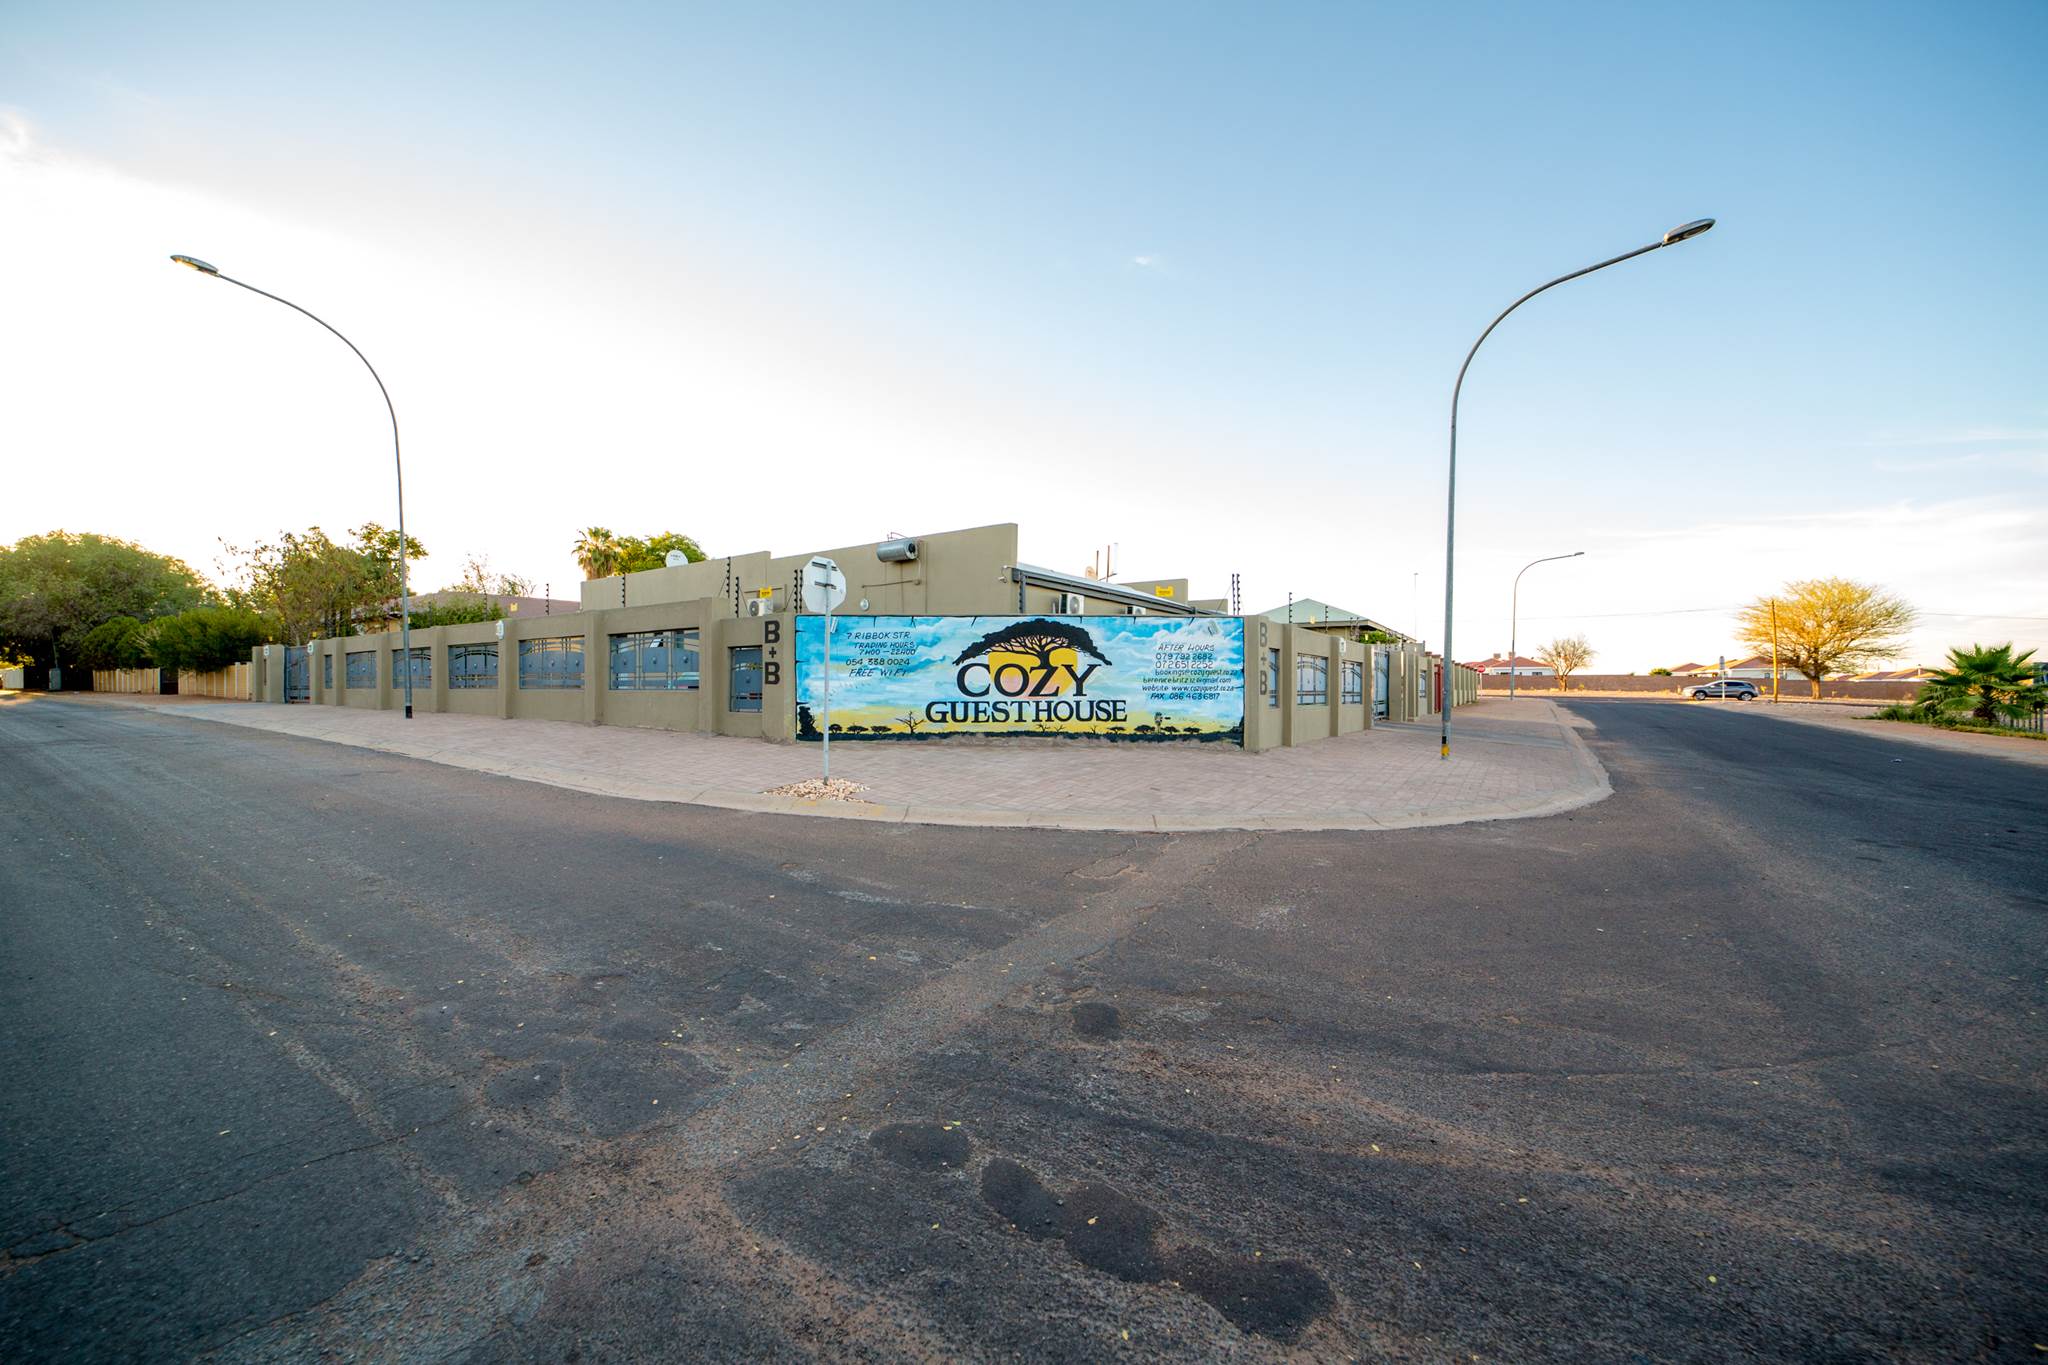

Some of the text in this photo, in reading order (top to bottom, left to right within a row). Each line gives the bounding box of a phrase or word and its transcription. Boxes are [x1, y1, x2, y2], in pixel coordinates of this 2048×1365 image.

[854, 631, 891, 640] RIBBOK
[854, 641, 915, 649] TRADING HOURS
[1158, 643, 1215, 651] AFTER HOURS
[849, 668, 875, 677] FREE
[956, 662, 1101, 698] COZY
[1150, 692, 1165, 700] FAX
[925, 700, 1128, 723] GUESTHOUSE
